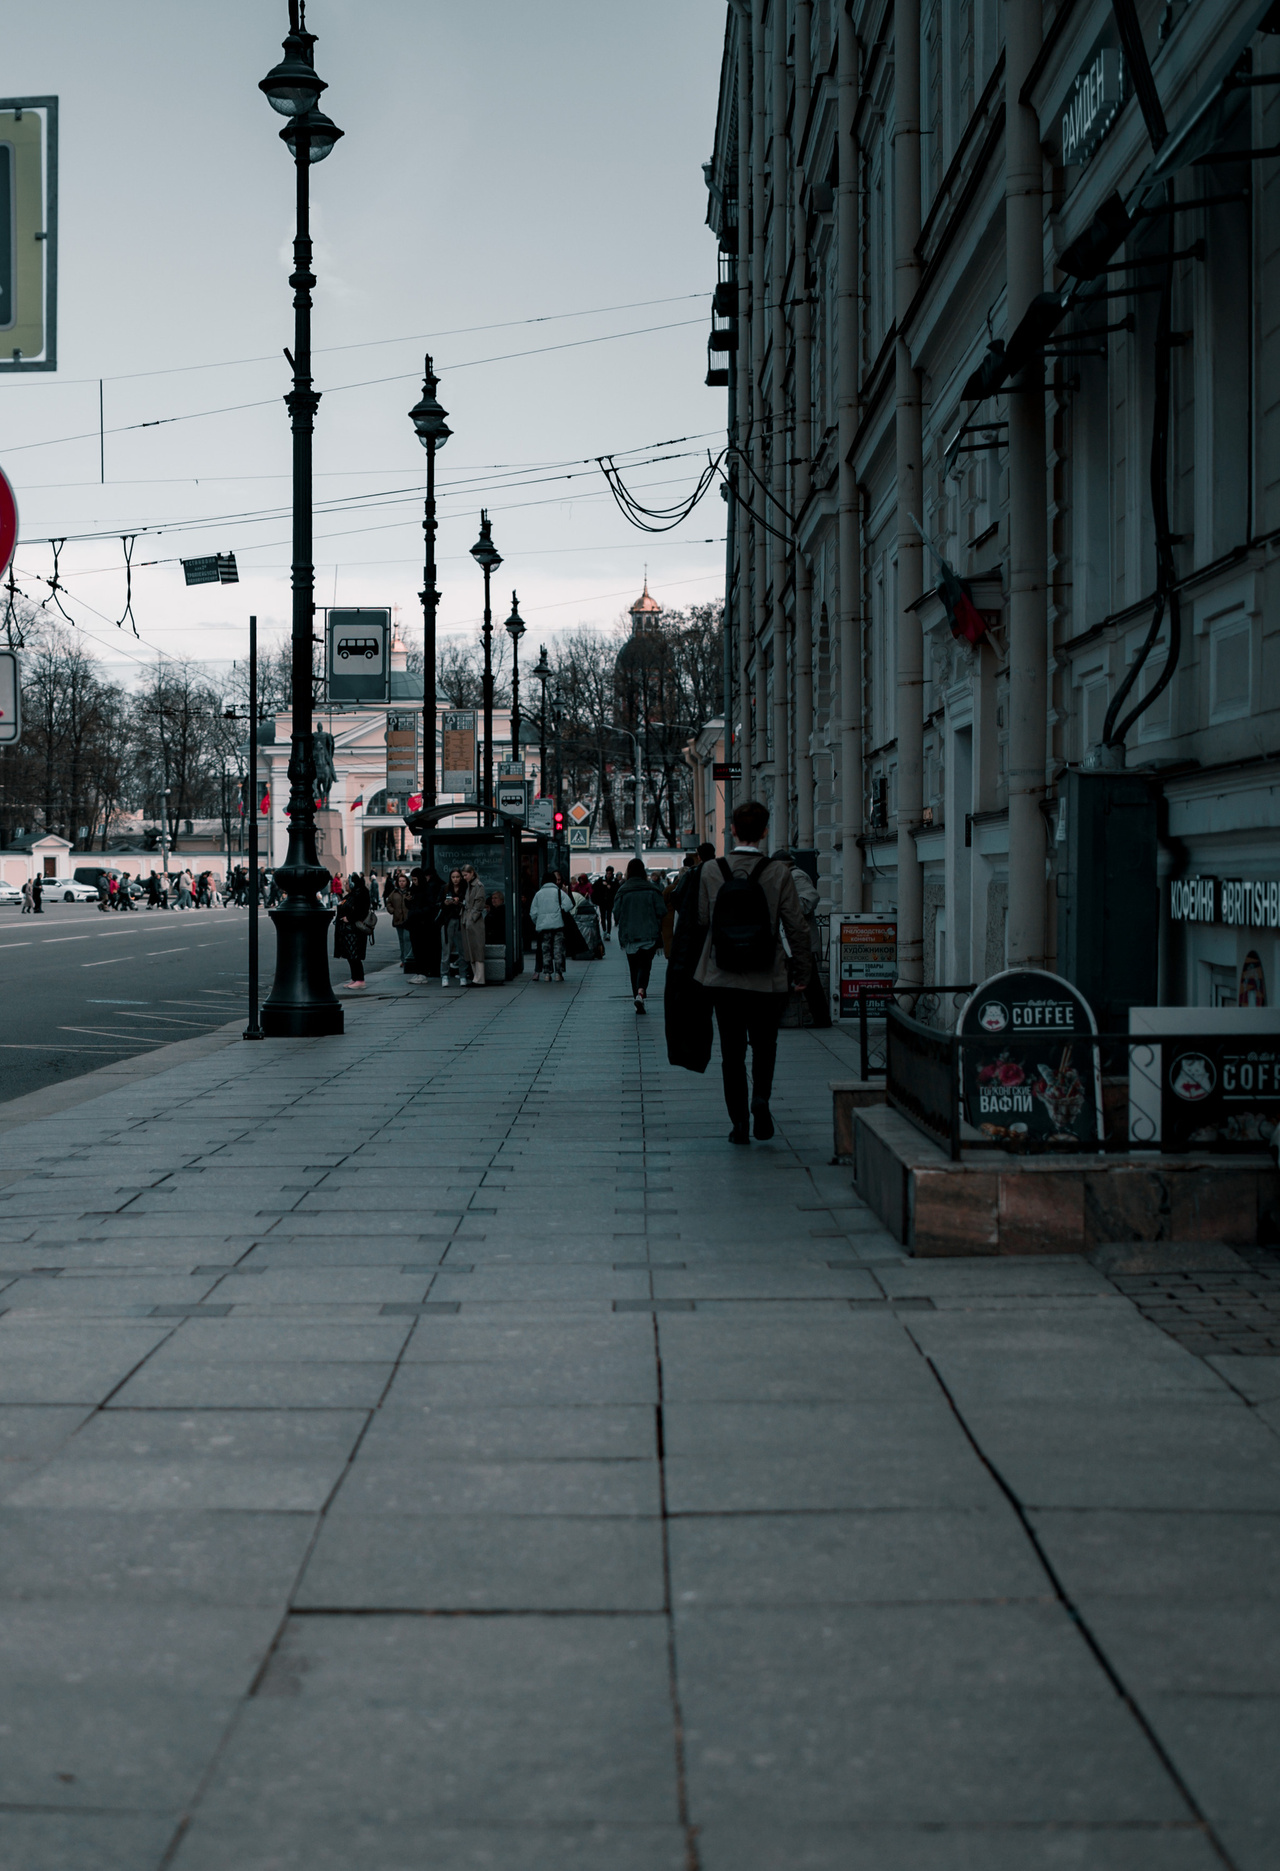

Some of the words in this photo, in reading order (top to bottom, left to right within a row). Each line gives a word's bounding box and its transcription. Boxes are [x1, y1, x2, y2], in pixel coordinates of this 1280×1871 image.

[1062, 48, 1104, 167] РАЙДЕН
[1170, 874, 1214, 922] КОФЕЙНЯ
[1012, 1006, 1074, 1025] COFFEE
[980, 1095, 1033, 1113] ВАФЛИ
